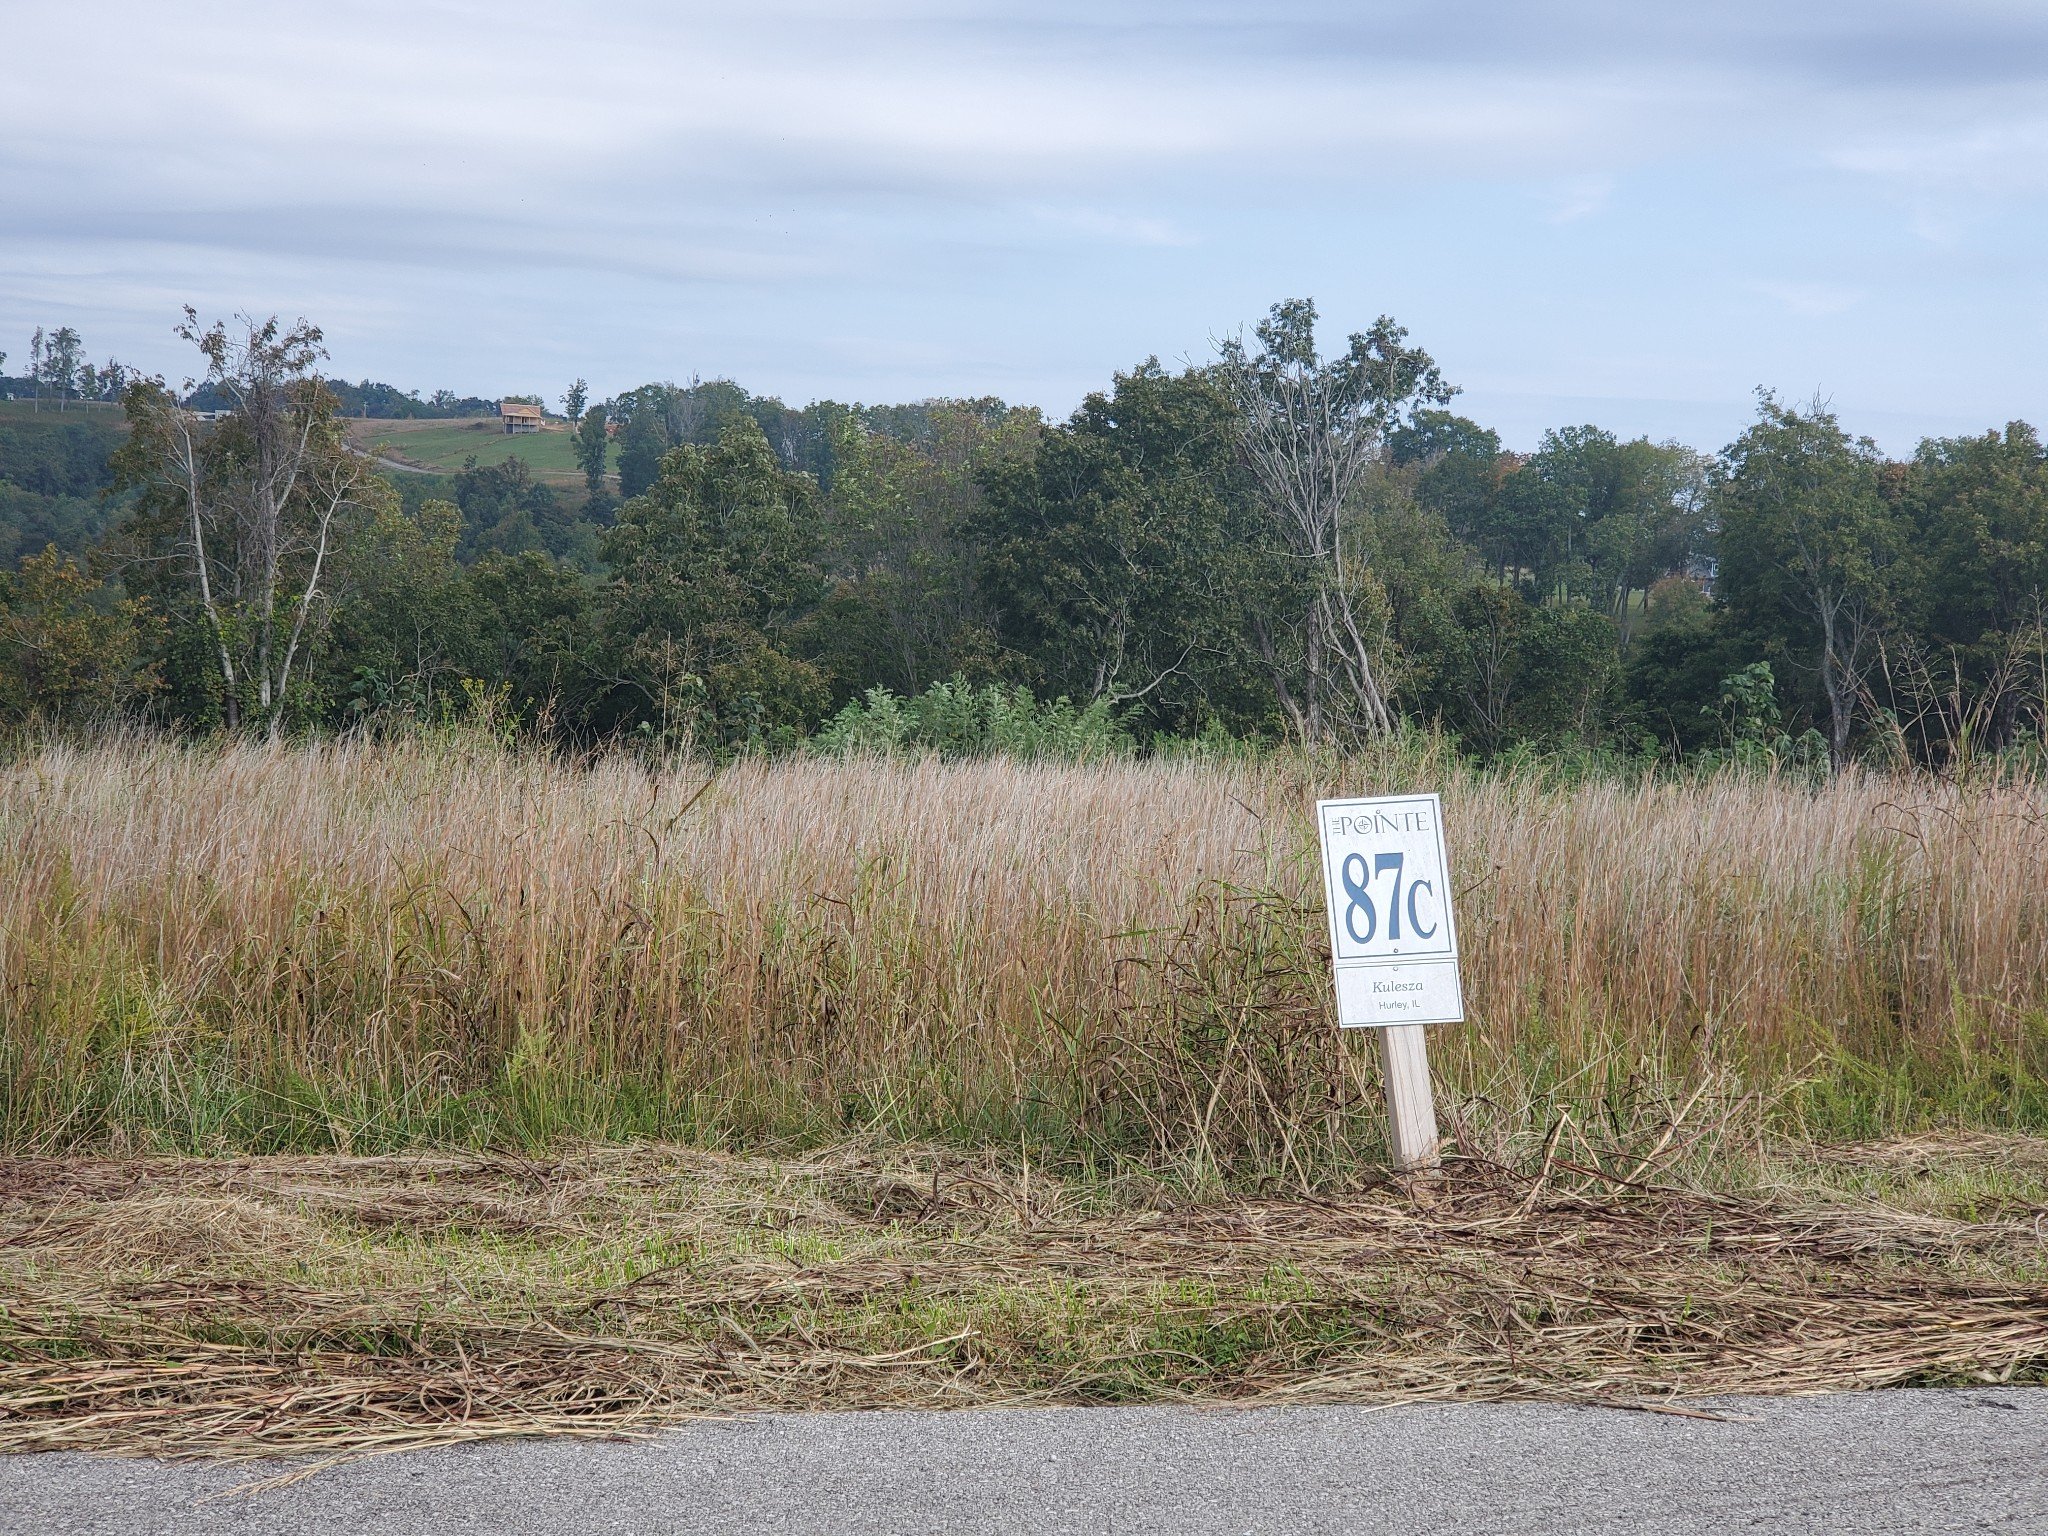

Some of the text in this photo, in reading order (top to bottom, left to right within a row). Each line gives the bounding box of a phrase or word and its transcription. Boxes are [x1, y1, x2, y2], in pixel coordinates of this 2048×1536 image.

[1331, 811, 1430, 836] THE POINTE
[1372, 981, 1424, 994] Kulesza
[1378, 999, 1421, 1011] Hurley, IL
